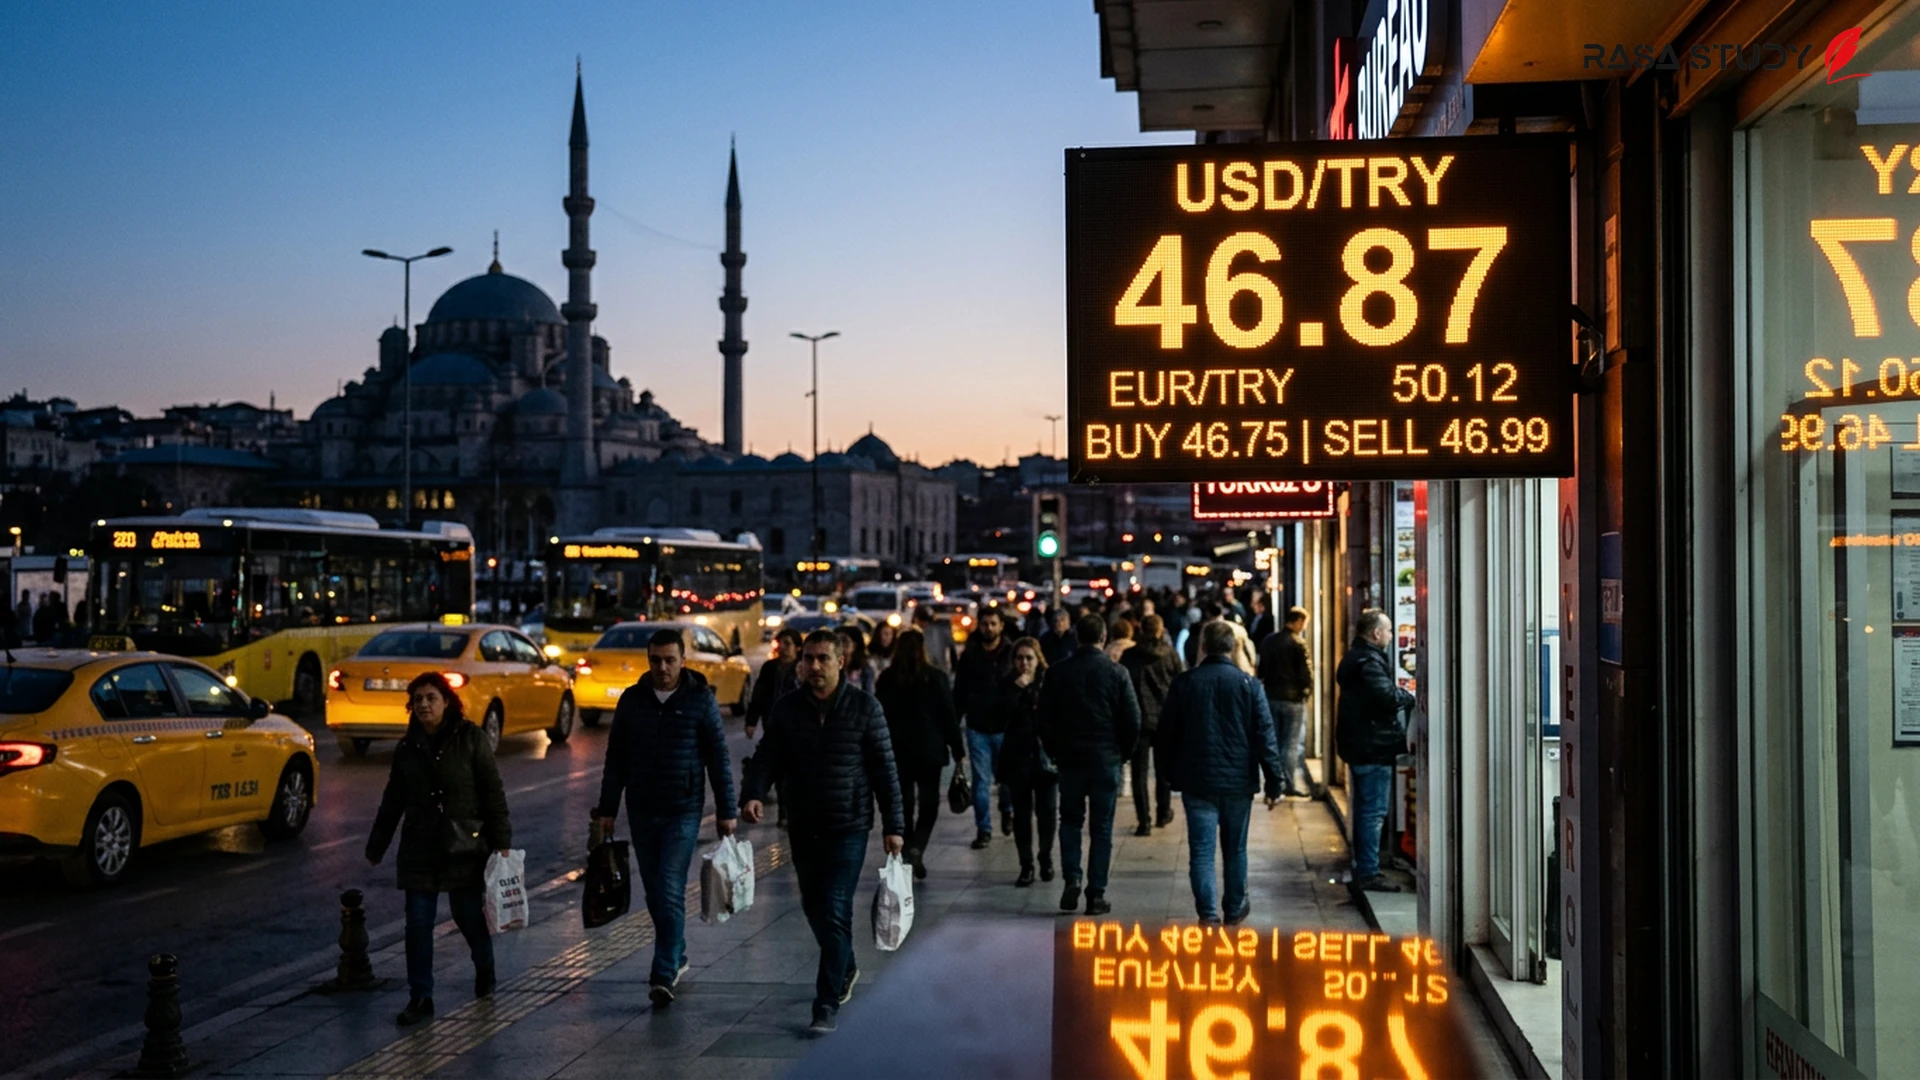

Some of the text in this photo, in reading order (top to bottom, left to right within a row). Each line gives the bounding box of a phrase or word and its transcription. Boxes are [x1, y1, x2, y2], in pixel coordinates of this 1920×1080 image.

[1177, 156, 1454, 212] USD/TRY
[1114, 226, 1508, 349] 46.87
[1110, 363, 1518, 407] EUR/TRY 50.12
[1087, 423, 1172, 460] BUY
[1182, 421, 1289, 457] 46.75
[1323, 419, 1428, 456] SELL
[1440, 417, 1550, 455] 46.99
